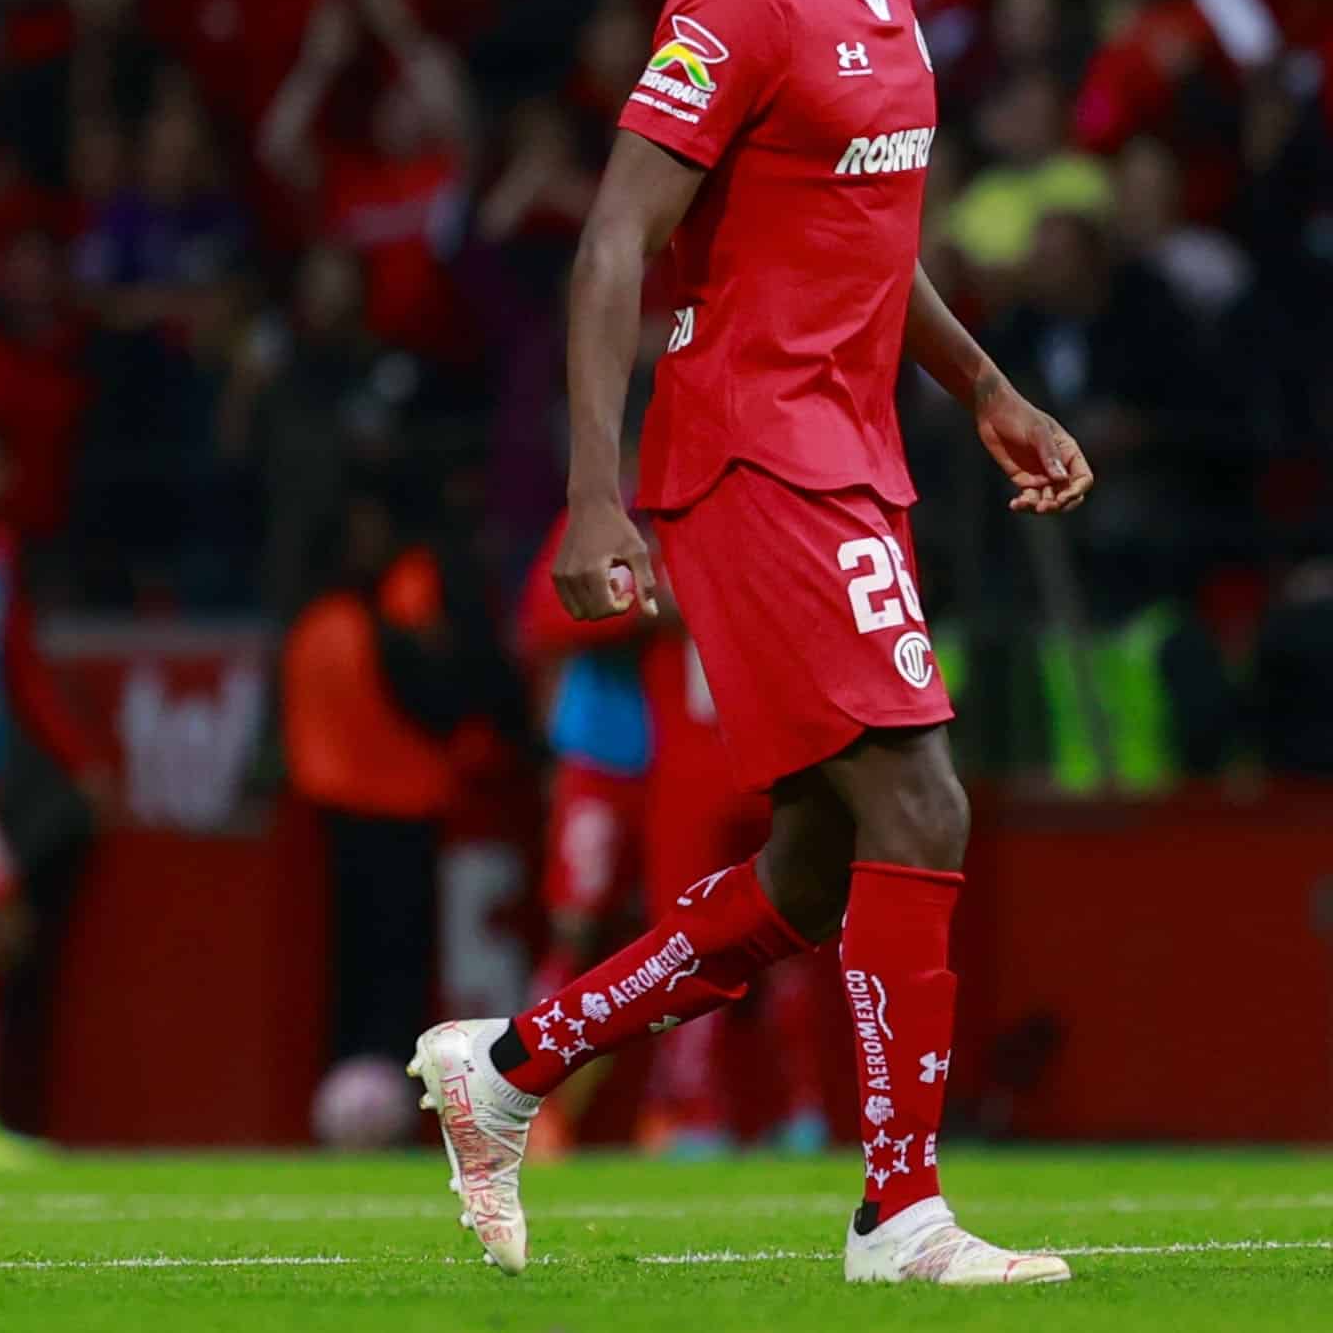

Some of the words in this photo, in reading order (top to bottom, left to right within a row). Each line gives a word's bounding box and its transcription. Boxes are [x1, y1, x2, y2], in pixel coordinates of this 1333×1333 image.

[837, 535, 925, 634] 26
[608, 931, 694, 1008] AEROMEXICO
[845, 969, 891, 1090] AEROMEXICO
